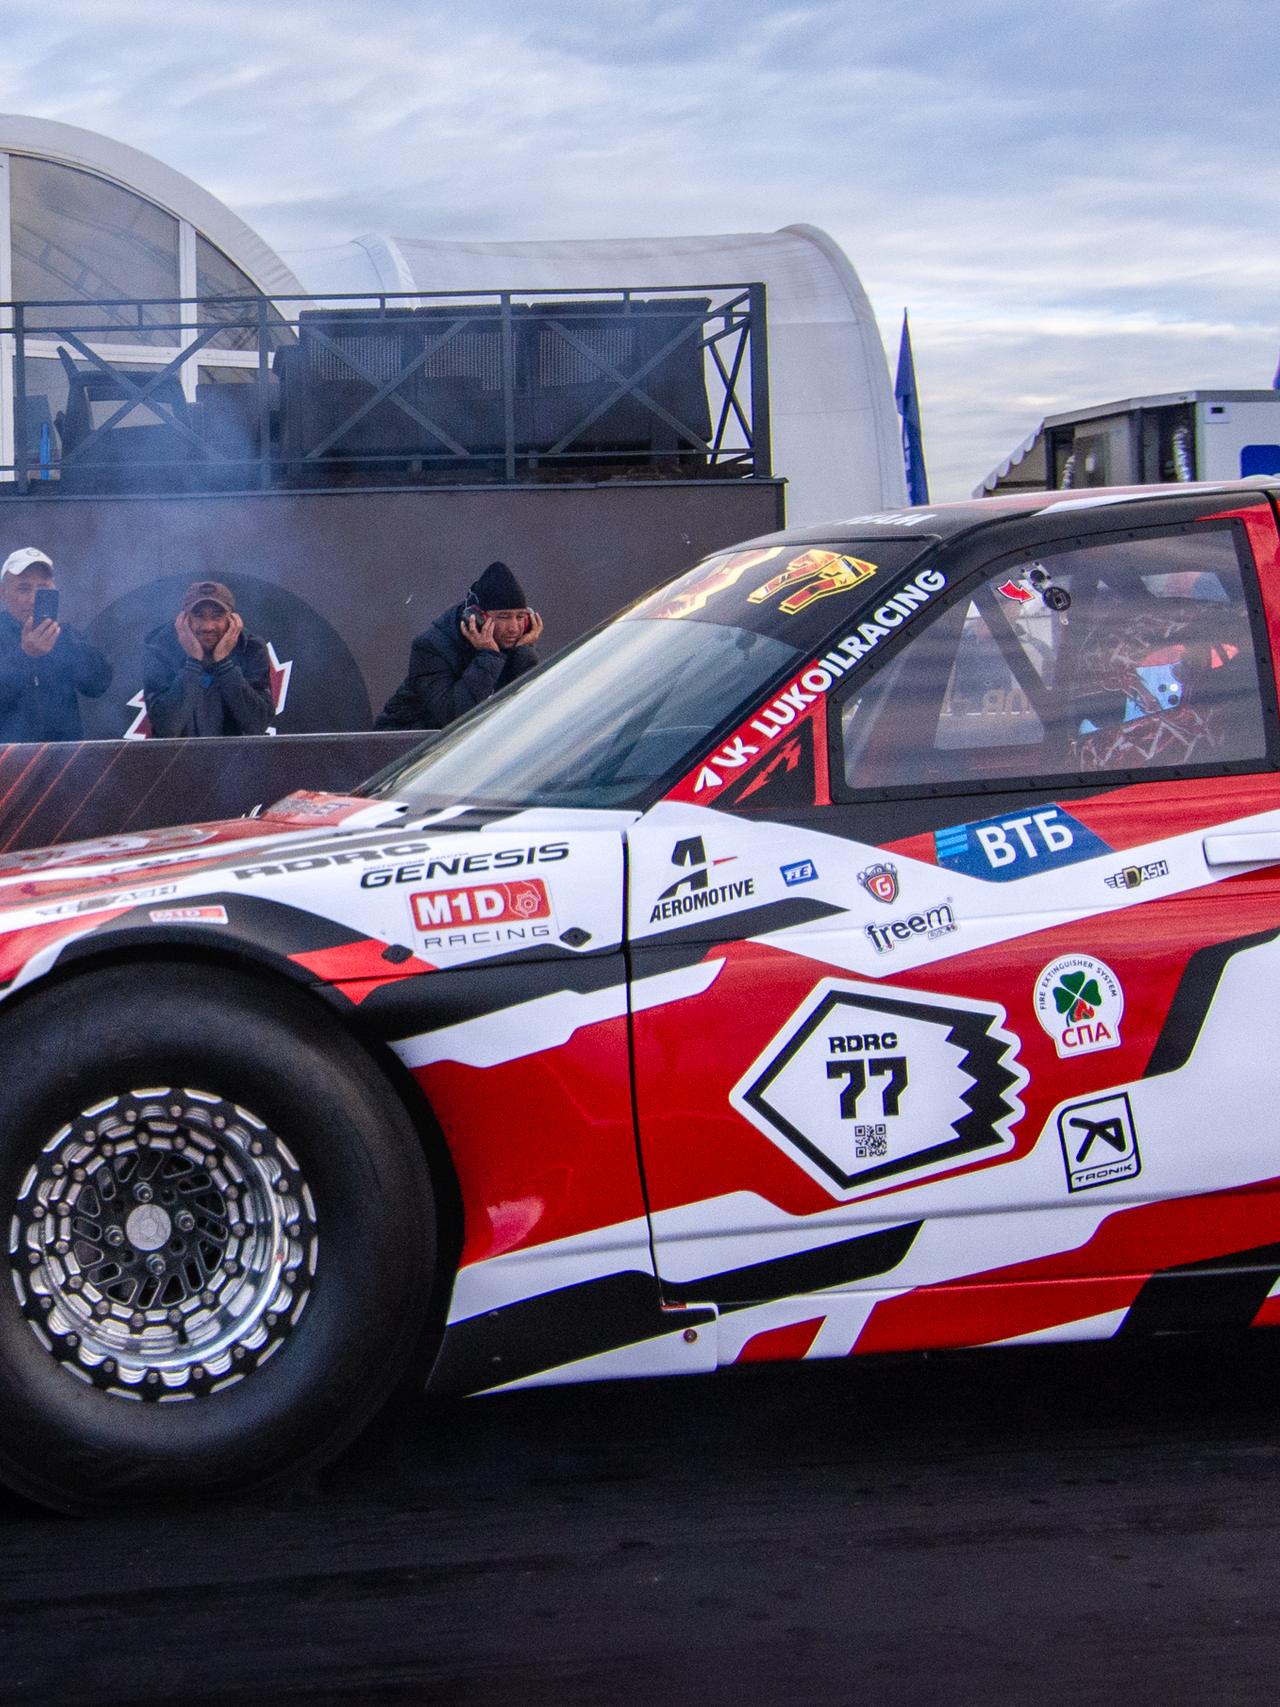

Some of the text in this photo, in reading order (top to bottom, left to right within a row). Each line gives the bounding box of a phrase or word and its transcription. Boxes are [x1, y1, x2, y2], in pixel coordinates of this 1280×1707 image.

[711, 736, 760, 768] VK
[975, 810, 1074, 868] ВТБ
[360, 842, 570, 889] GENESIS
[419, 887, 505, 927] M1D
[649, 877, 755, 924] AEROMOTIVE
[424, 925, 551, 950] RACING
[866, 905, 952, 952] freem
[1039, 959, 1118, 1010] FIRE EXTINGUISHER SYSTEM
[828, 1032, 898, 1054] RDRC
[1061, 1021, 1112, 1048] СПА
[826, 1056, 909, 1119] 77
[1075, 1164, 1132, 1182] TRONIK
